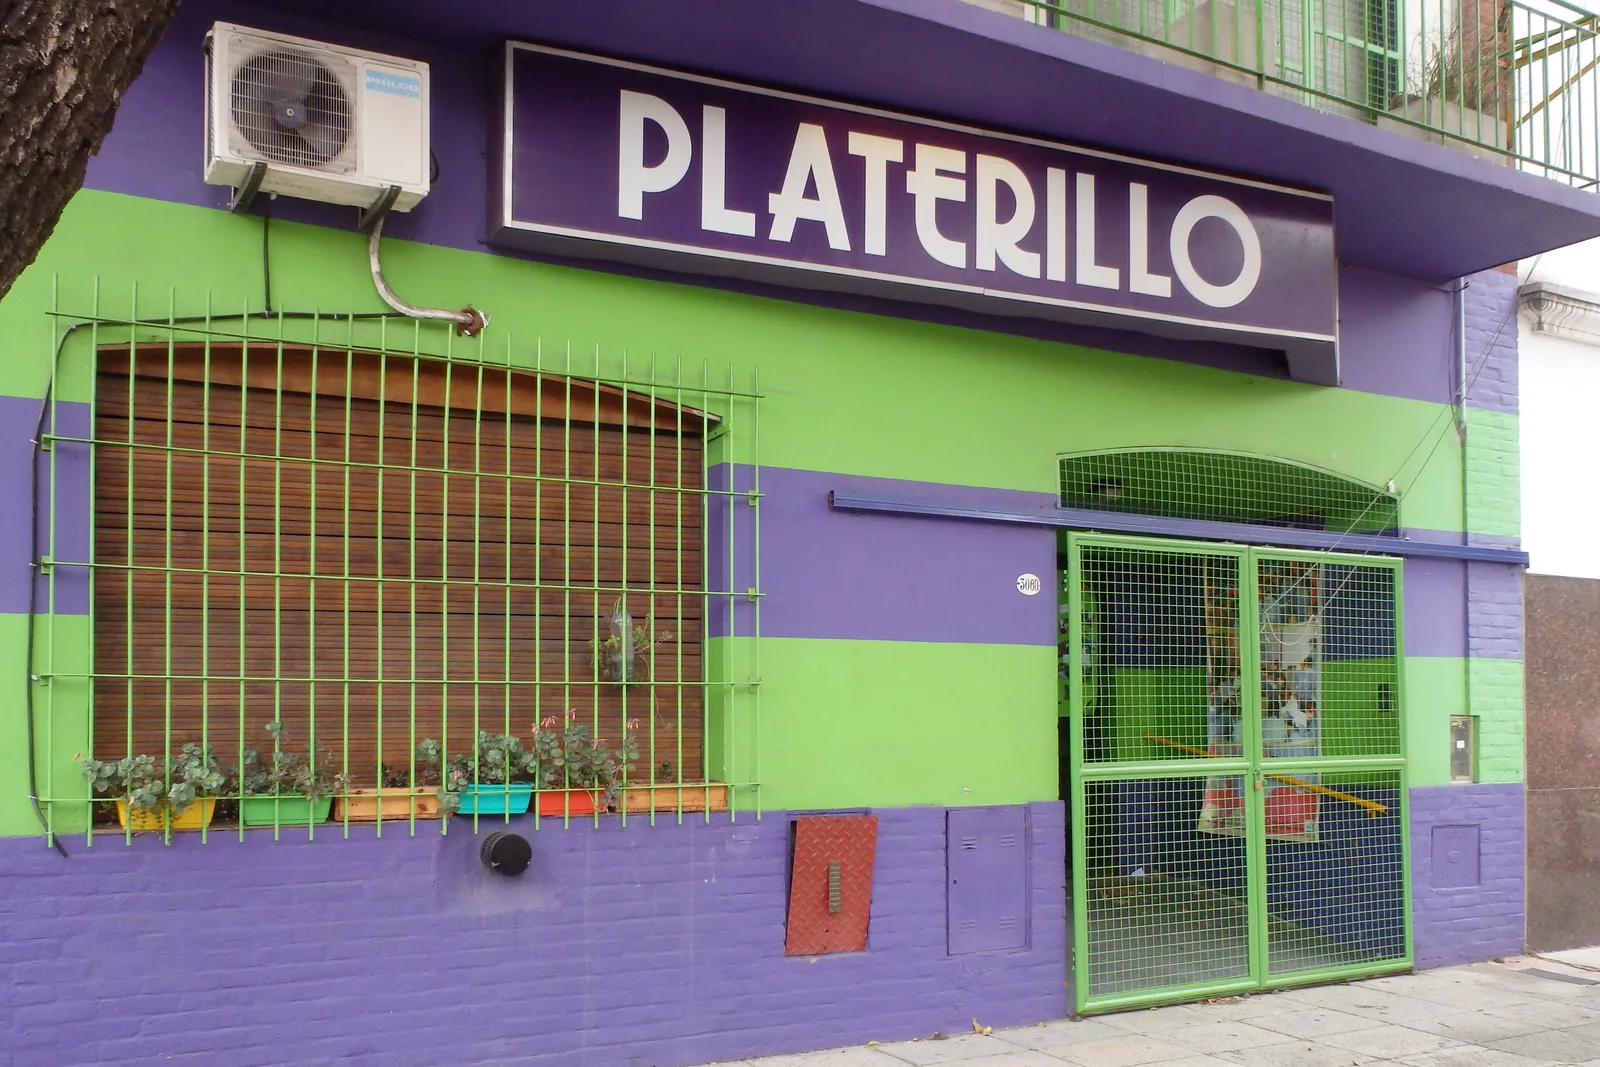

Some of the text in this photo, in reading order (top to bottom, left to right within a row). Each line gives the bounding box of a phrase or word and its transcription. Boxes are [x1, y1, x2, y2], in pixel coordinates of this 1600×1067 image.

[367, 76, 419, 92] PHILCO
[618, 90, 1262, 307] PLATERILLO
[1020, 578, 1039, 592] 3080
